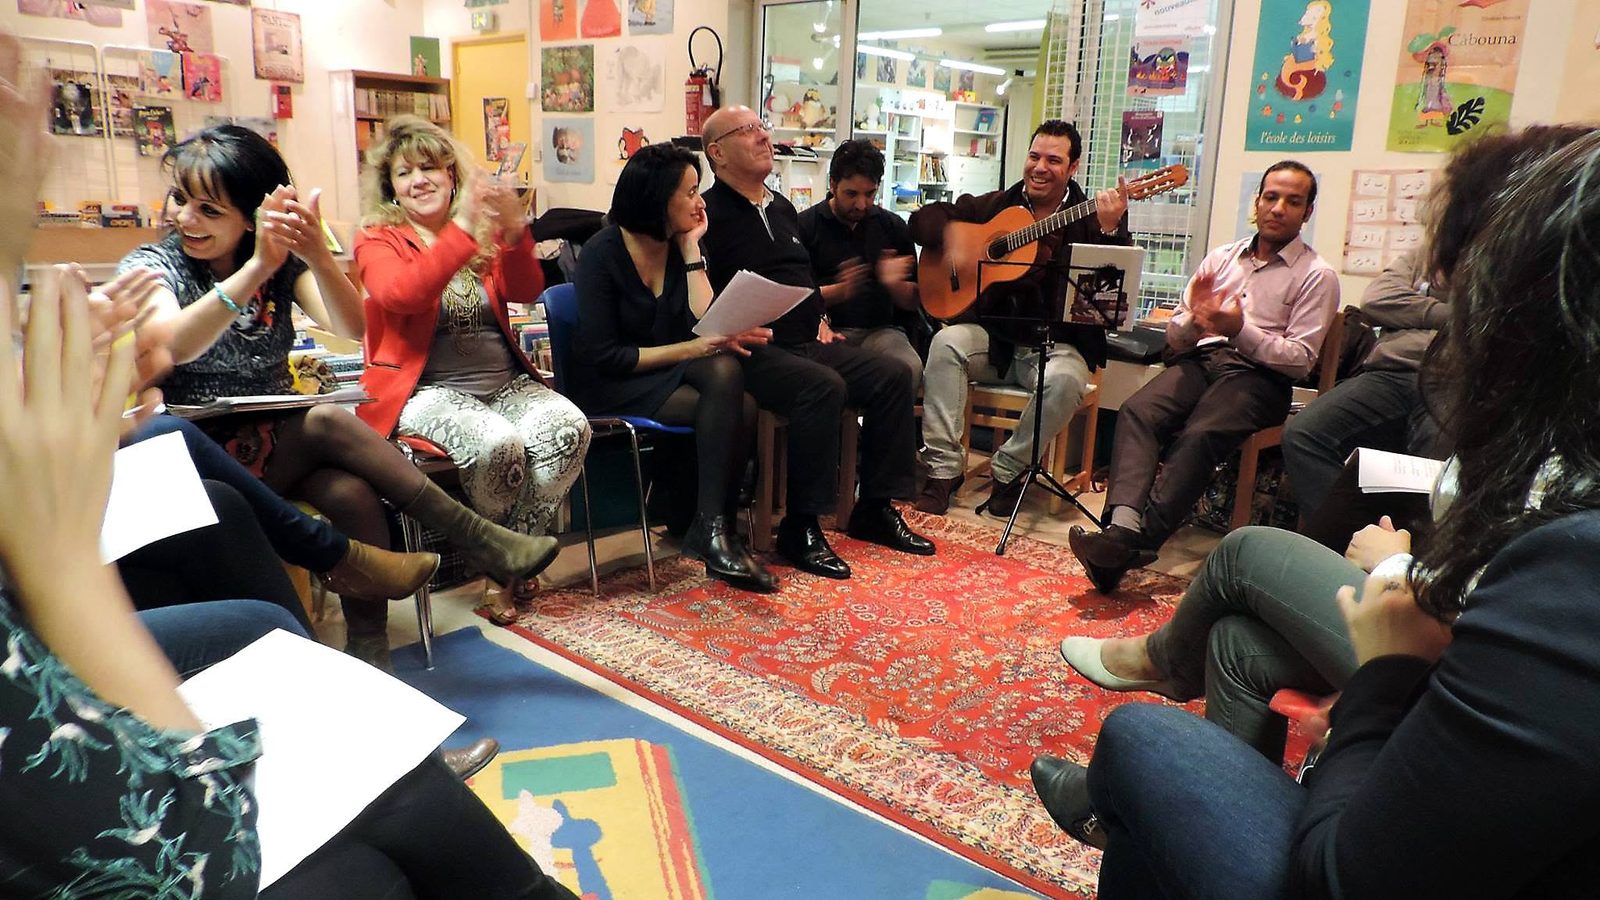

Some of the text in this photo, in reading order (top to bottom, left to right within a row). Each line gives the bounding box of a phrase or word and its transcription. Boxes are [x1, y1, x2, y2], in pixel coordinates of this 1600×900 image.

[1260, 131, 1336, 144] l'école des loisirs
